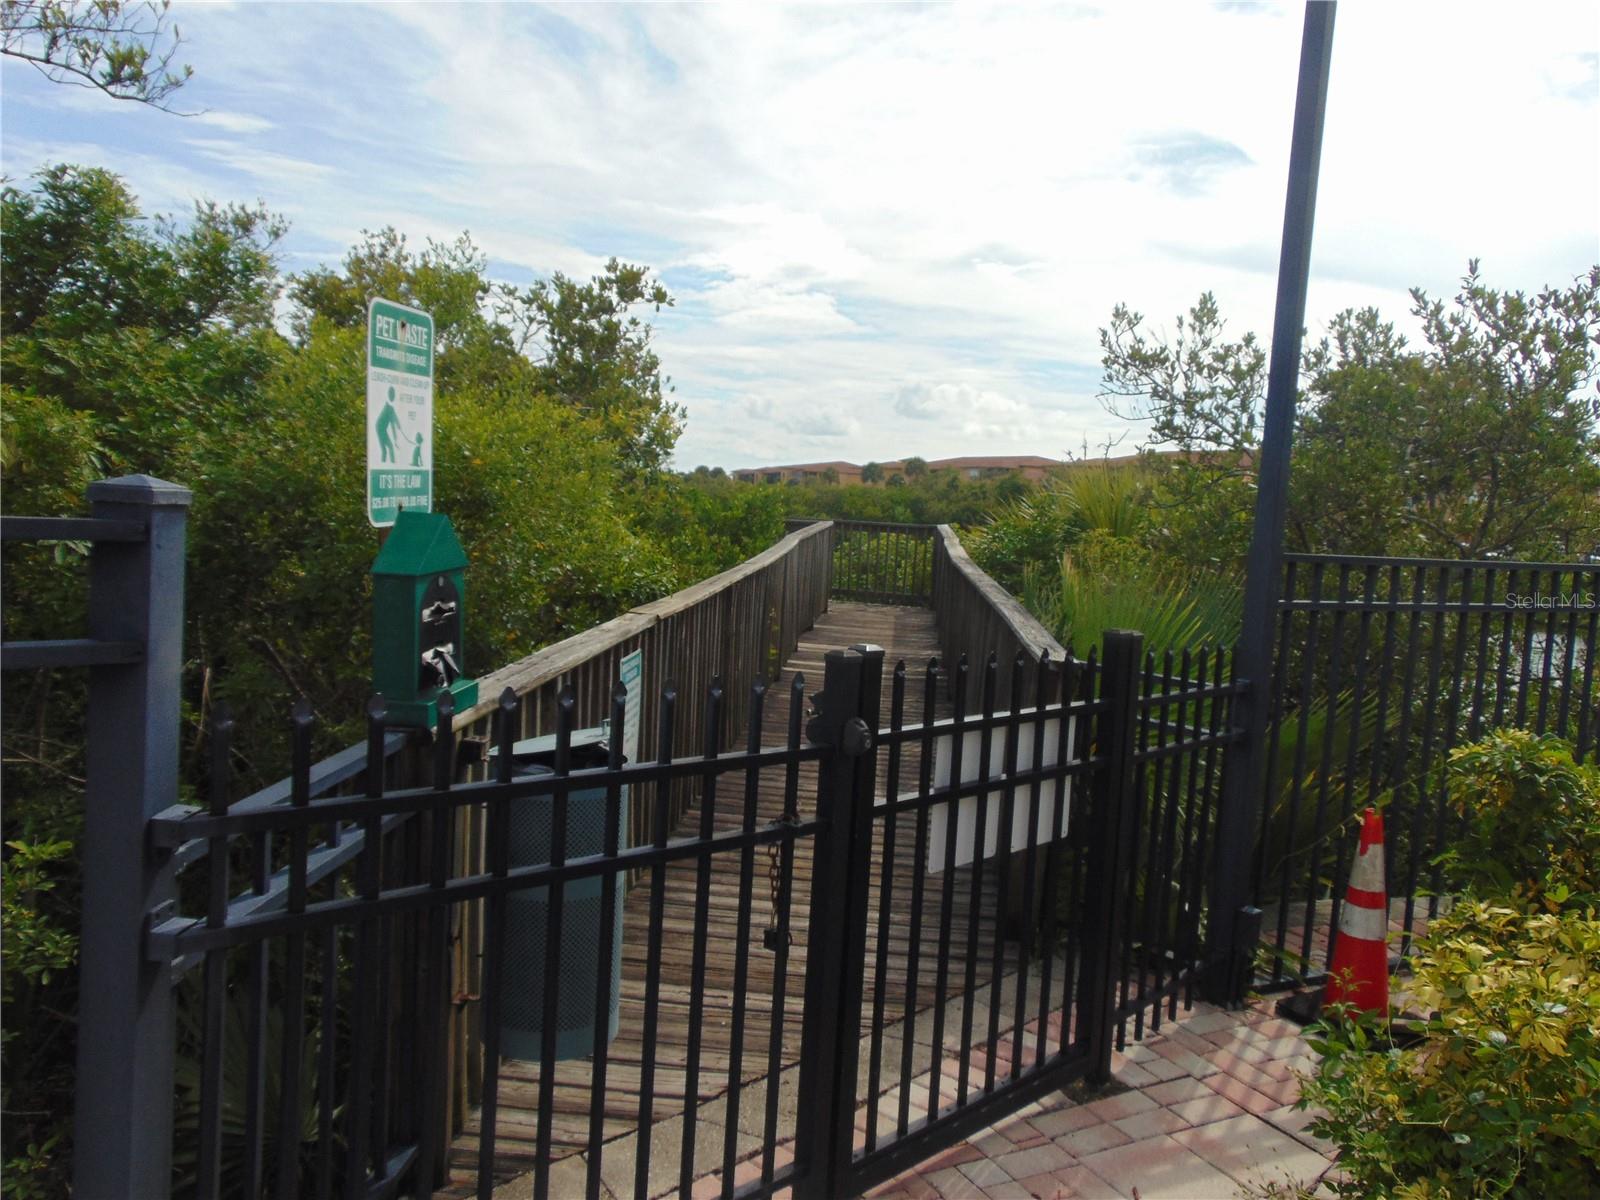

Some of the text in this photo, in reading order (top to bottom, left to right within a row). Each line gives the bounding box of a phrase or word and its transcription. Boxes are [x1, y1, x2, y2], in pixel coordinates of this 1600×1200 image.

[376, 314, 395, 338] PET
[379, 474, 421, 489] IT'S THE LAW
